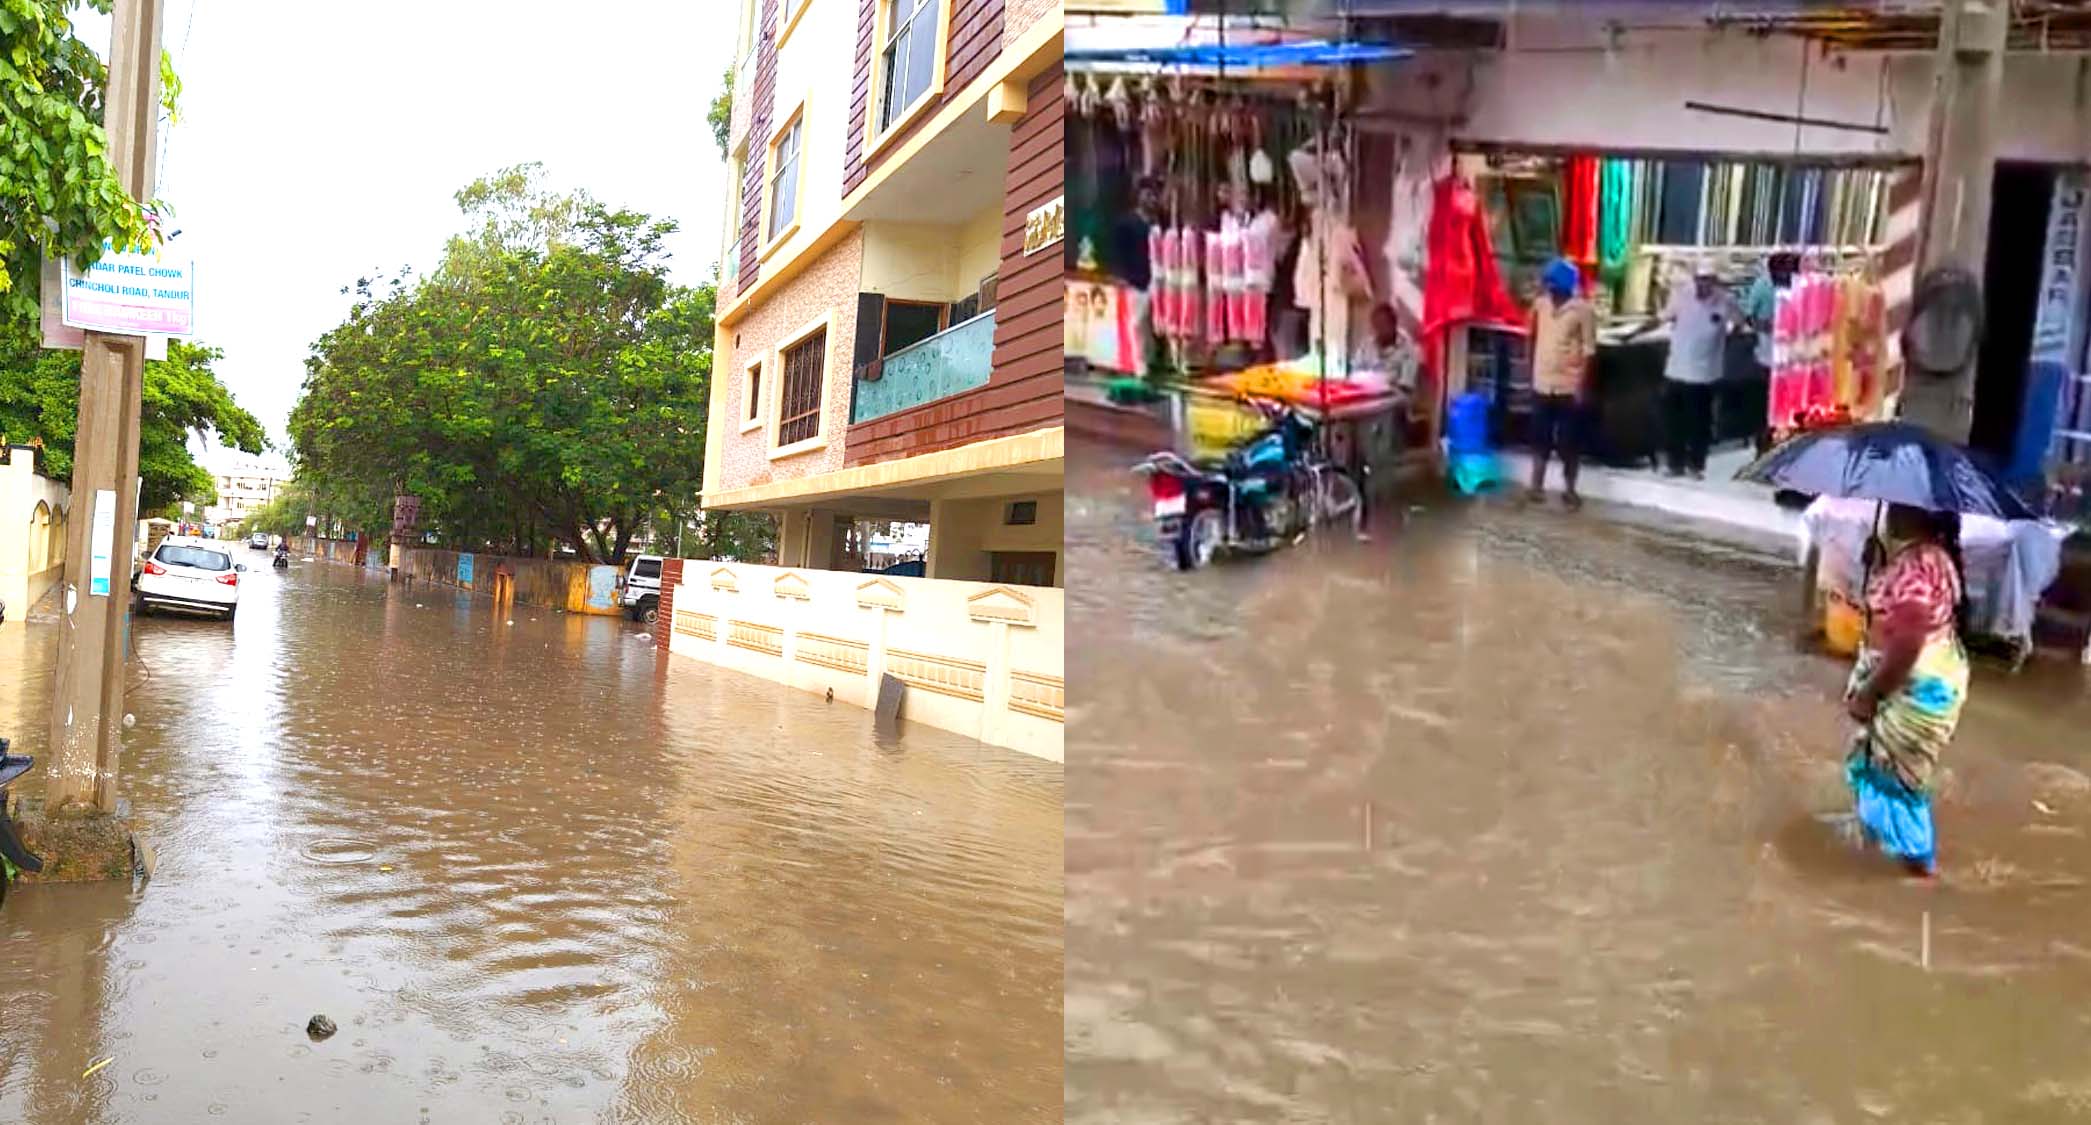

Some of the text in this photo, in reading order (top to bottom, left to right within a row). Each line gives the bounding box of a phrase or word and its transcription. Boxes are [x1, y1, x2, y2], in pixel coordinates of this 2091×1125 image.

[118, 264, 146, 276] PATEL
[149, 267, 183, 279] CHOWK
[69, 278, 190, 301] CHINCHOLI ROAD, TANDUR
